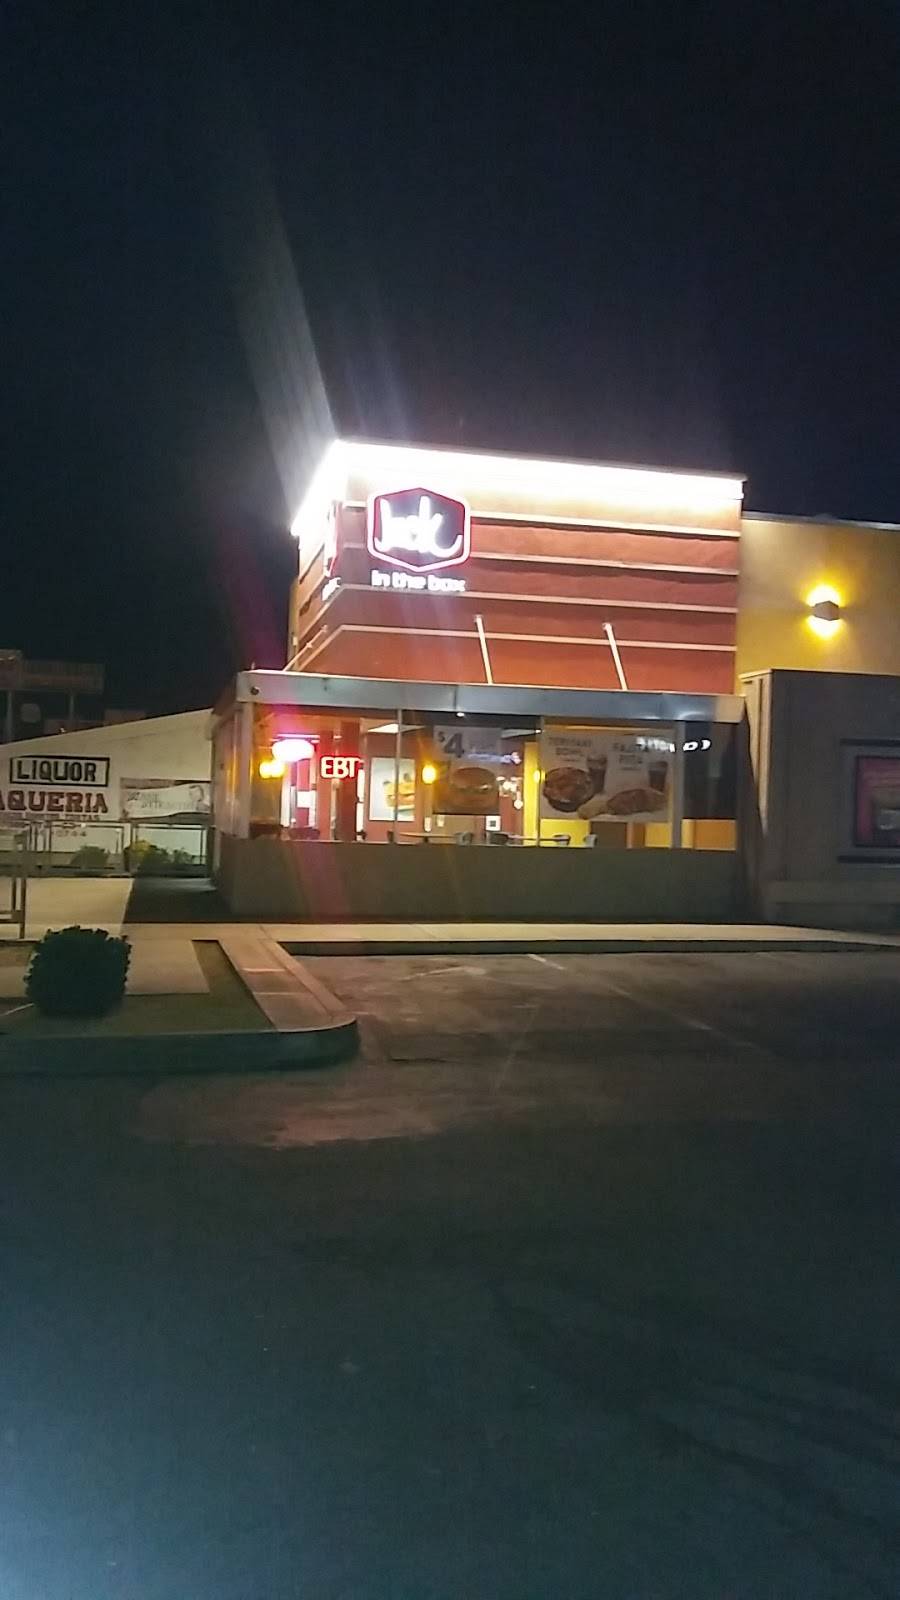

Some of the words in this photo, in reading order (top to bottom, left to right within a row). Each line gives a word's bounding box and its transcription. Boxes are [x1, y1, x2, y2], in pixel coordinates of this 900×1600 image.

[427, 574, 466, 592] box
[17, 760, 97, 782] LIQUOR
[321, 756, 362, 778] EBT
